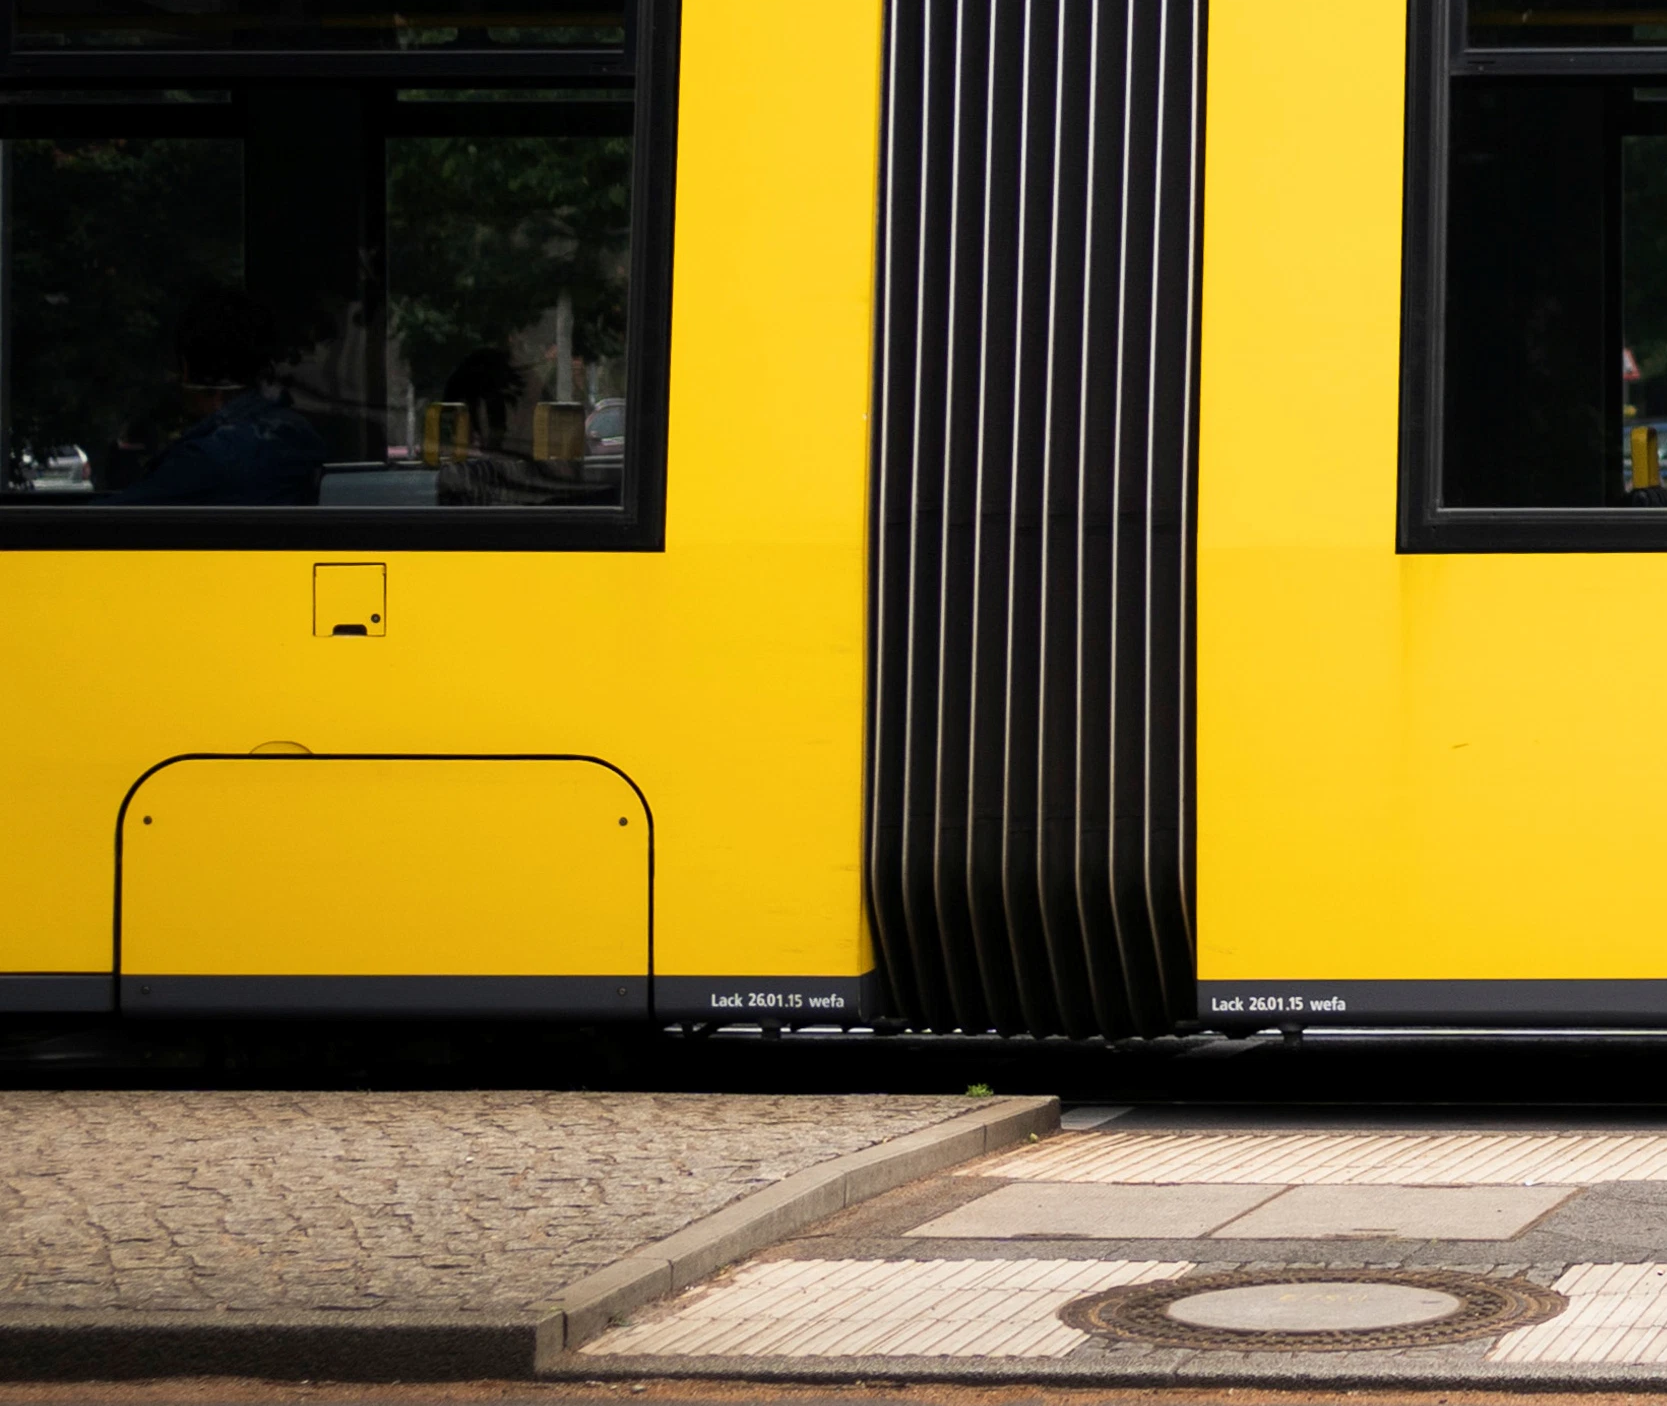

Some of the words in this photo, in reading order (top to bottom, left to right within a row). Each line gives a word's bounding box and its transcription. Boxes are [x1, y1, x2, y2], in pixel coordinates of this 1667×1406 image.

[711, 993, 744, 1007] Lack
[748, 993, 803, 1008] 26.01.15
[808, 993, 845, 1008] wefa
[1212, 996, 1244, 1011] Lack
[1249, 996, 1304, 1011] 26.01.15
[1310, 996, 1346, 1011] wefa
